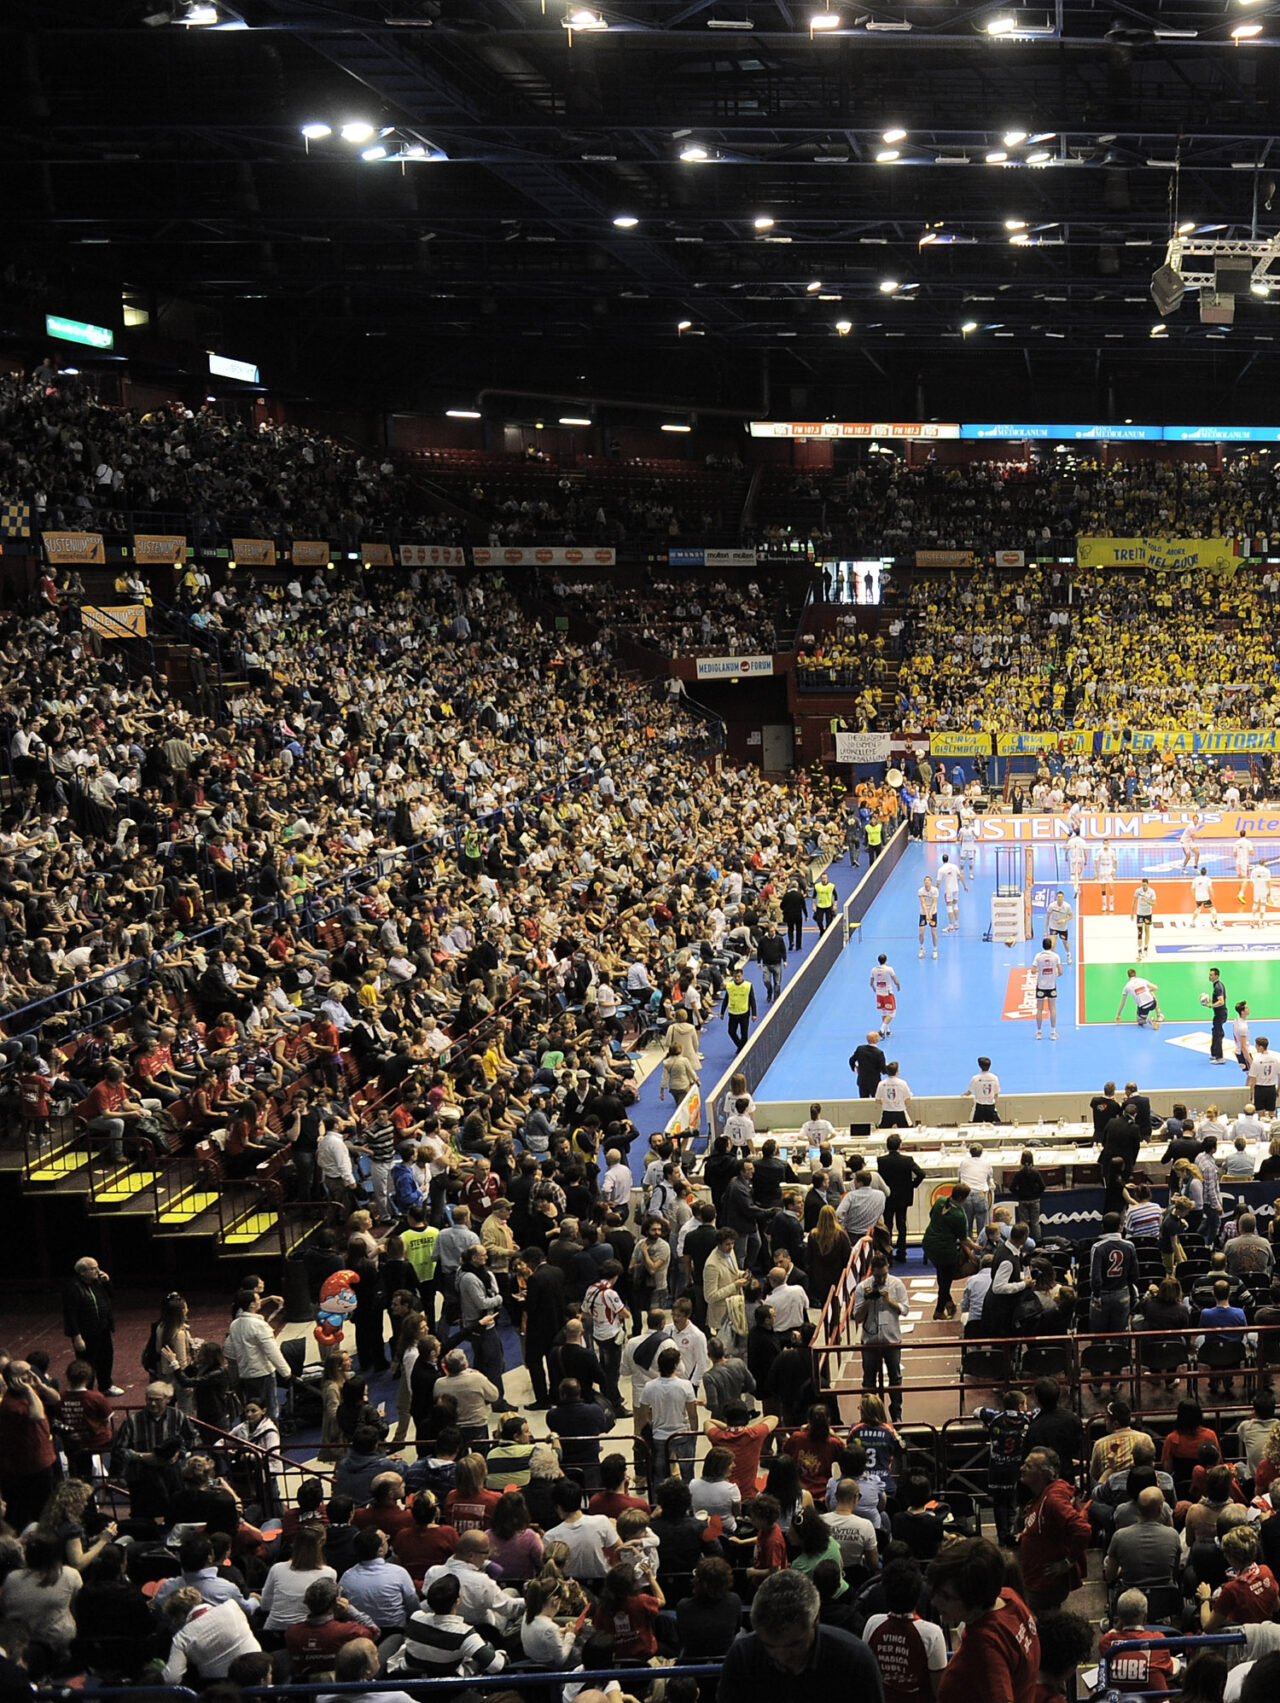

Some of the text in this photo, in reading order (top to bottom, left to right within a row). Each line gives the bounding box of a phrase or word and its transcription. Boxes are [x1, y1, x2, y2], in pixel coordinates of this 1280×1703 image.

[44, 537, 88, 553] SUSTENIUM
[698, 661, 772, 673] MEDIOLANUM FORUM
[944, 734, 977, 744] CURVA
[1011, 734, 1043, 744] CRVA
[1196, 732, 1276, 750] VITTORIA
[410, 1237, 434, 1248] STEWARD
[1107, 1249, 1124, 1278] 2
[865, 1447, 877, 1468] 3
[882, 1633, 906, 1645] VINCI
[877, 1644, 909, 1657] PER NOI
[878, 1654, 909, 1666] MAGICA
